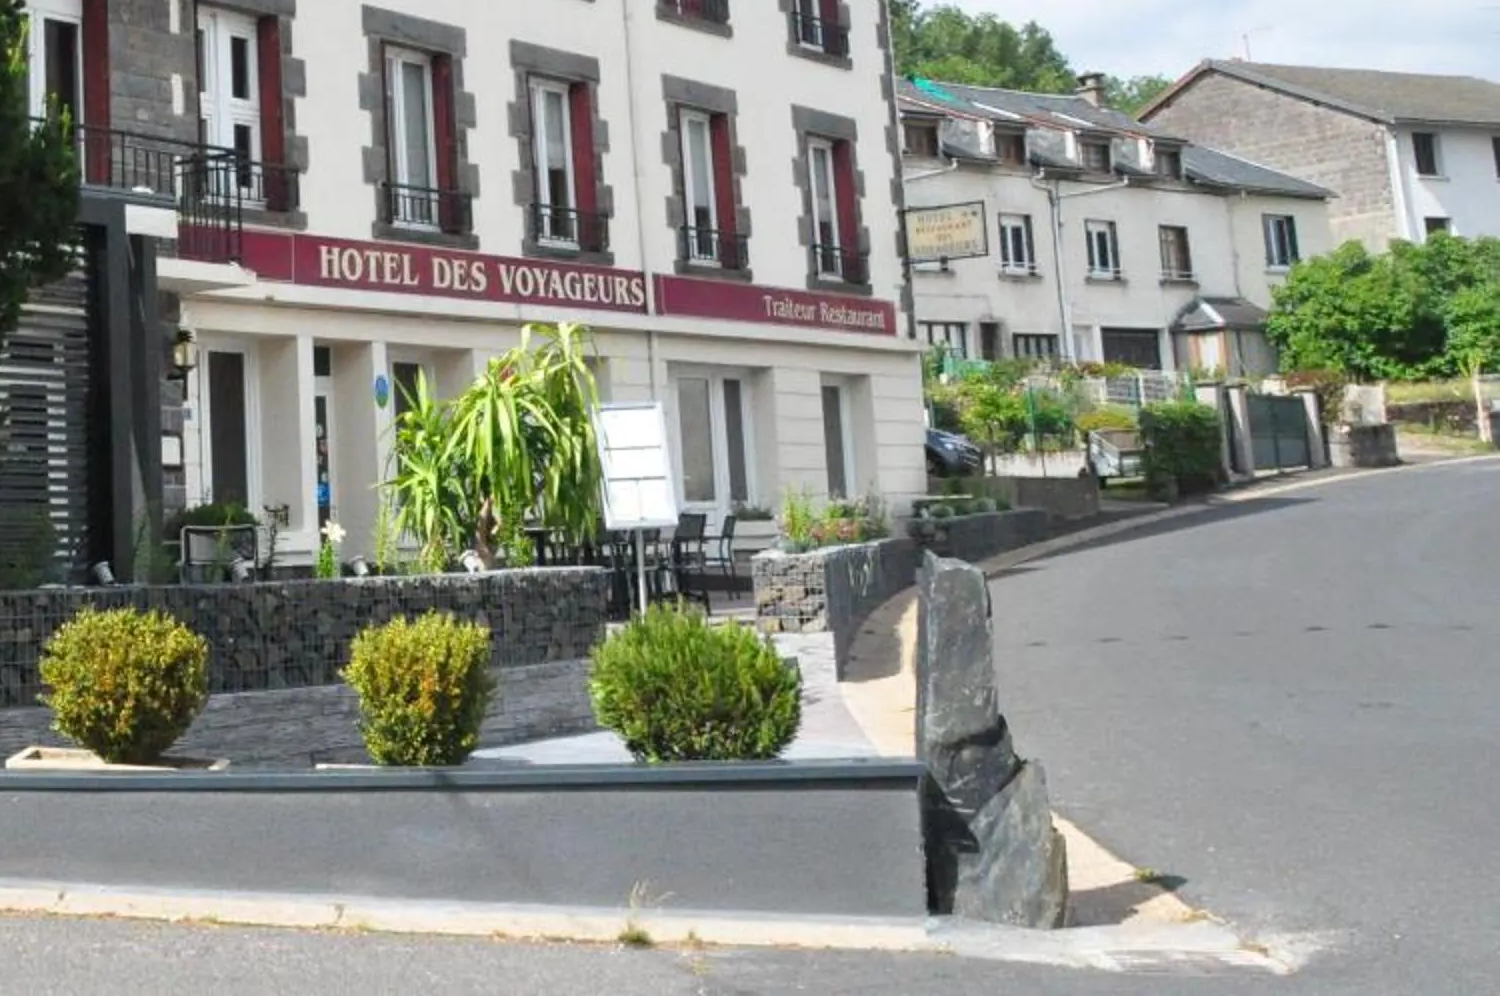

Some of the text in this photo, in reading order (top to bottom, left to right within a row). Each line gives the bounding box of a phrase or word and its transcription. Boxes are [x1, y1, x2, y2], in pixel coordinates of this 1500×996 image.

[320, 245, 645, 306] HOTEL DES VOYAGEURS
[763, 295, 885, 329] Traiteur Restaurant
